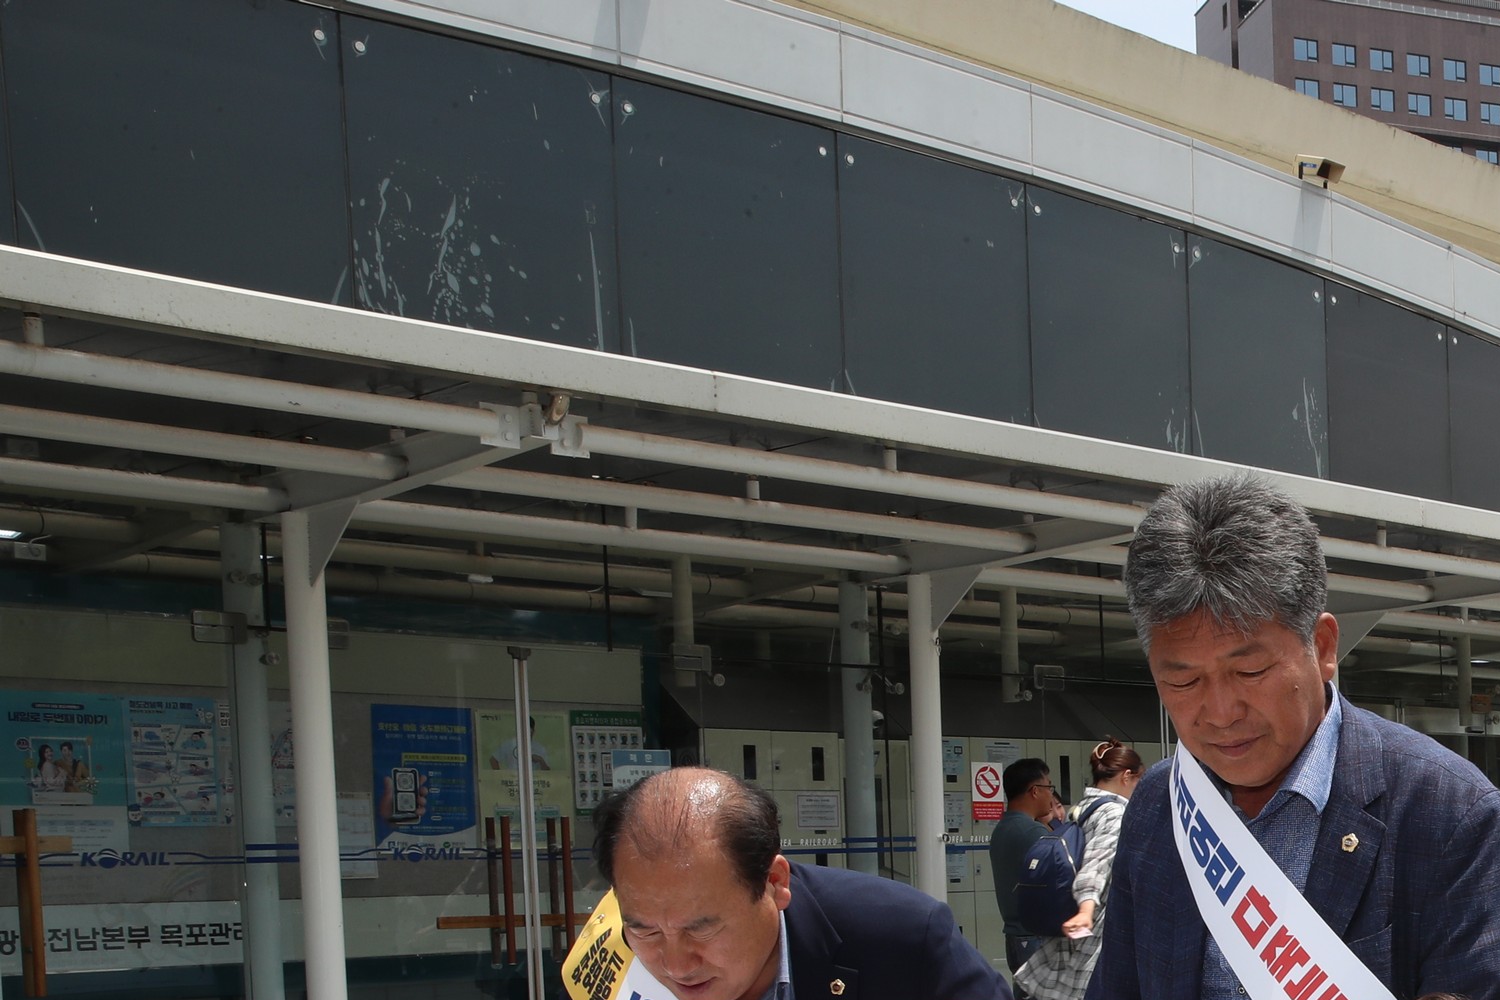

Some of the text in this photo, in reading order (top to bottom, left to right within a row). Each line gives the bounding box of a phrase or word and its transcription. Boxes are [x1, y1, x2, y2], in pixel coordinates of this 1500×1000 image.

[8, 711, 108, 725] 내일로 두번째 이야기
[799, 837, 838, 847] RAILROAD
[0, 923, 152, 956] 광전남본부
[571, 927, 613, 986] 후쿠시마
[582, 947, 609, 994] 오염수
